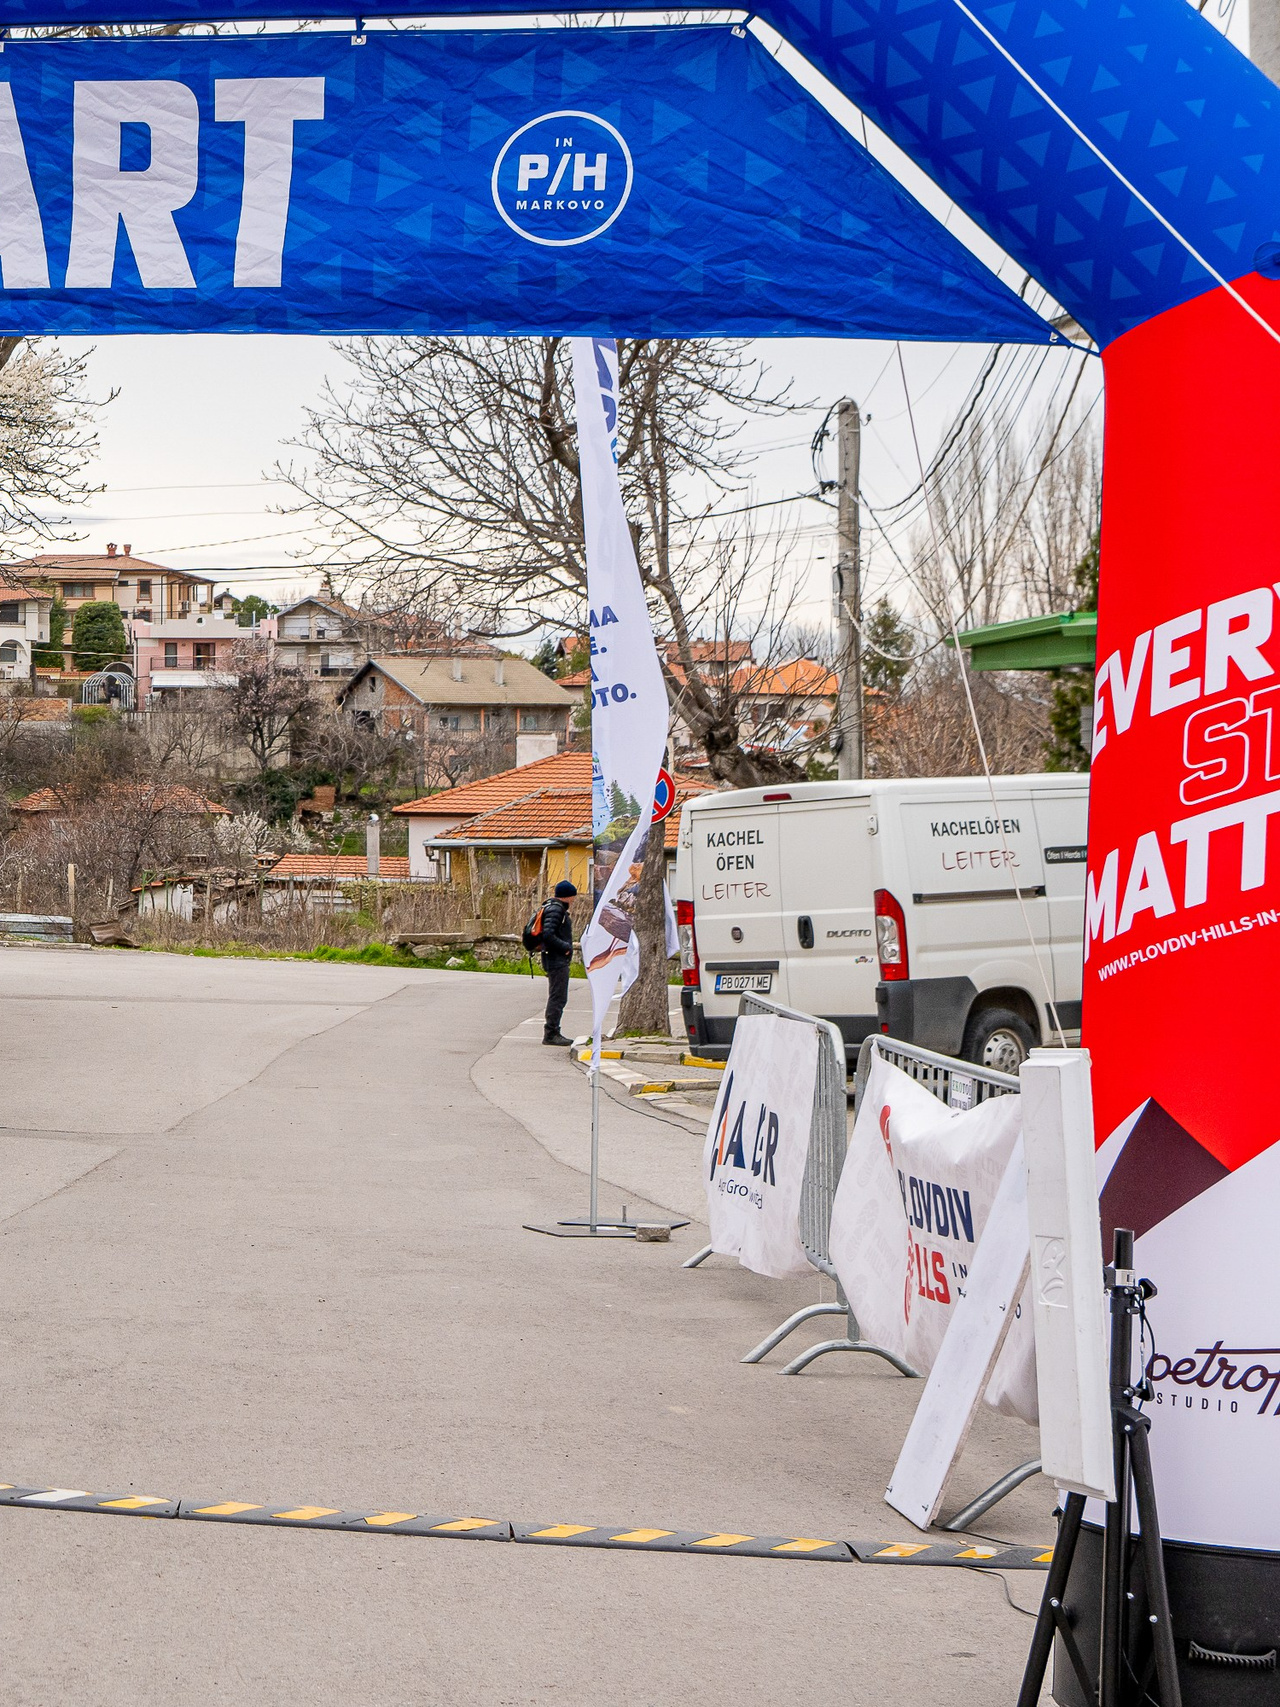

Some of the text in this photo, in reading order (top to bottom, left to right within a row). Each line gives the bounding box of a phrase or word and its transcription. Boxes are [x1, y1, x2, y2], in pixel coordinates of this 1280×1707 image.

[555, 137, 573, 148] IN
[517, 153, 607, 195] P/H
[516, 200, 604, 210] MARKOVO
[1091, 580, 1280, 765] EVER
[931, 817, 1020, 837] KACHELÖFEN
[707, 830, 764, 848] KACHEL
[716, 853, 755, 871] ÖFEN
[942, 850, 1020, 871] LEITER
[702, 882, 771, 900] LEITER
[826, 929, 872, 938] DUCATO
[721, 976, 769, 989] PB 0271 ME
[952, 1262, 968, 1279] IN
[1156, 1392, 1238, 1413] STUDIO
